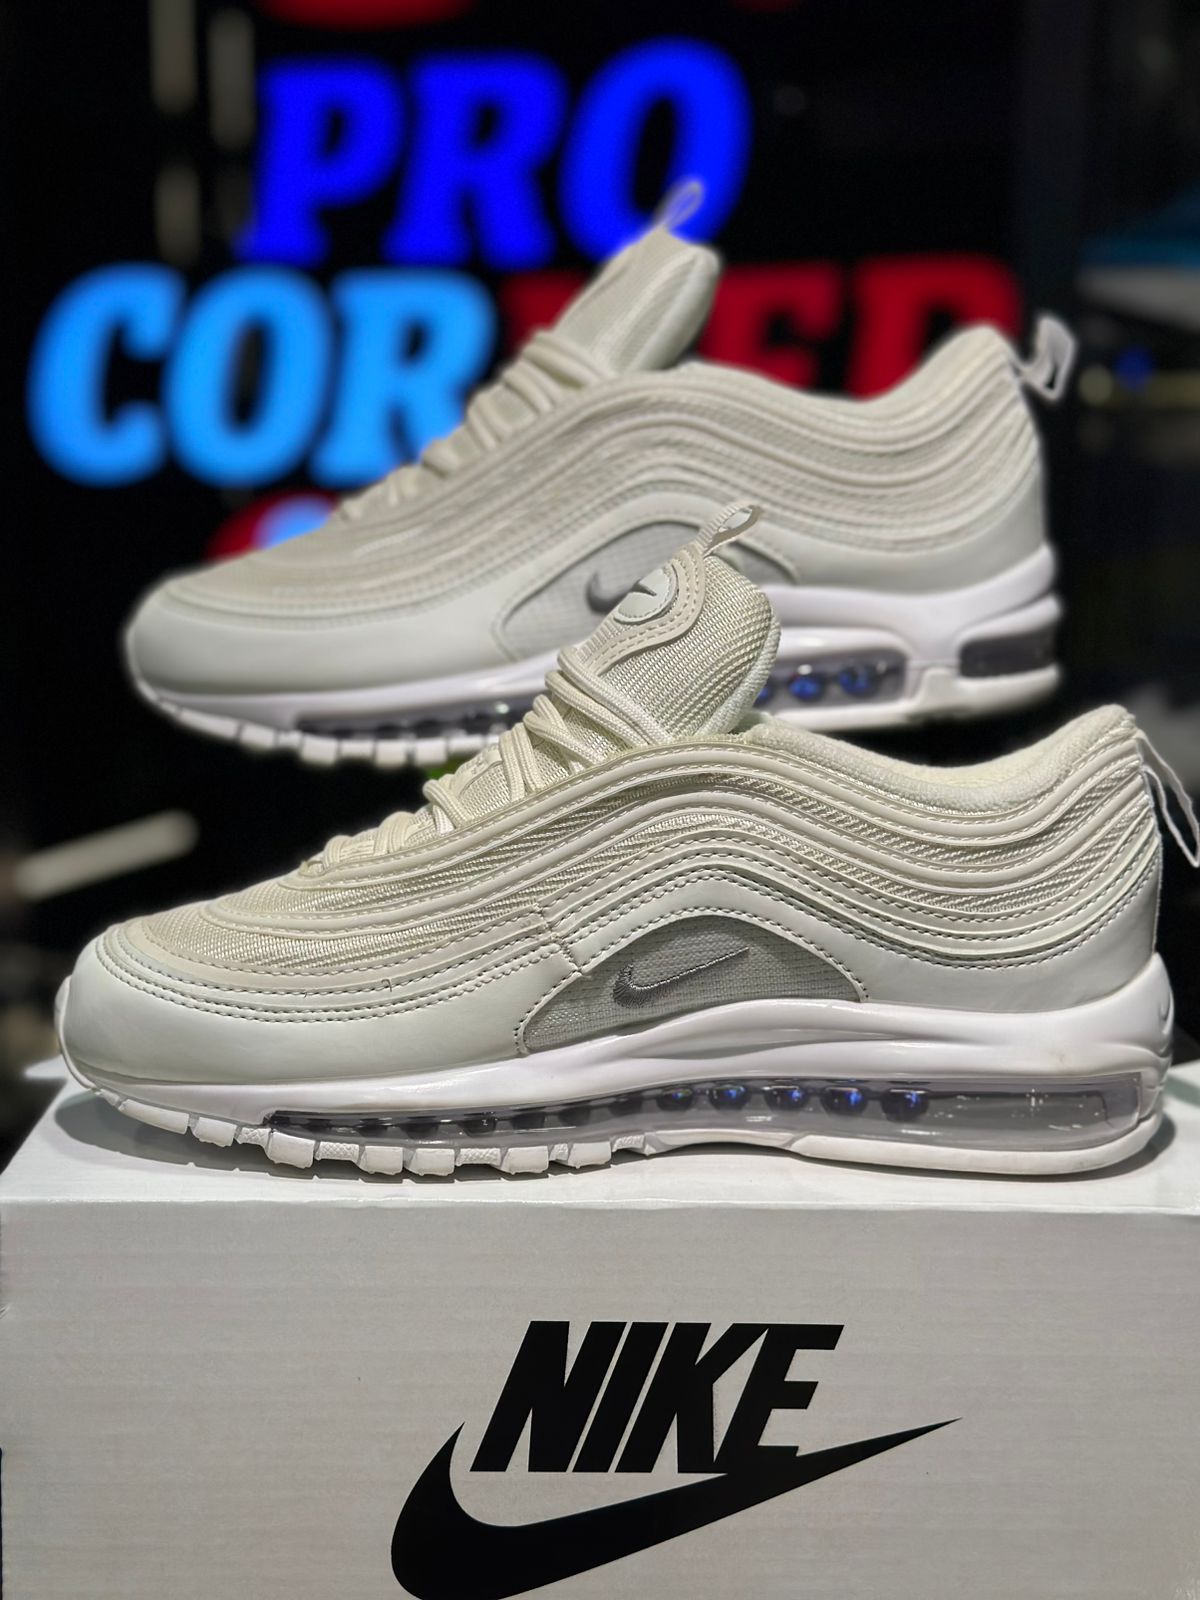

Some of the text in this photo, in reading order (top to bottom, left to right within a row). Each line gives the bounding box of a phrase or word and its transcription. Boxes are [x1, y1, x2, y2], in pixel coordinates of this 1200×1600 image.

[234, 38, 751, 267] PRO
[27, 257, 1019, 487] CORE
[470, 1320, 844, 1473] NIKE
